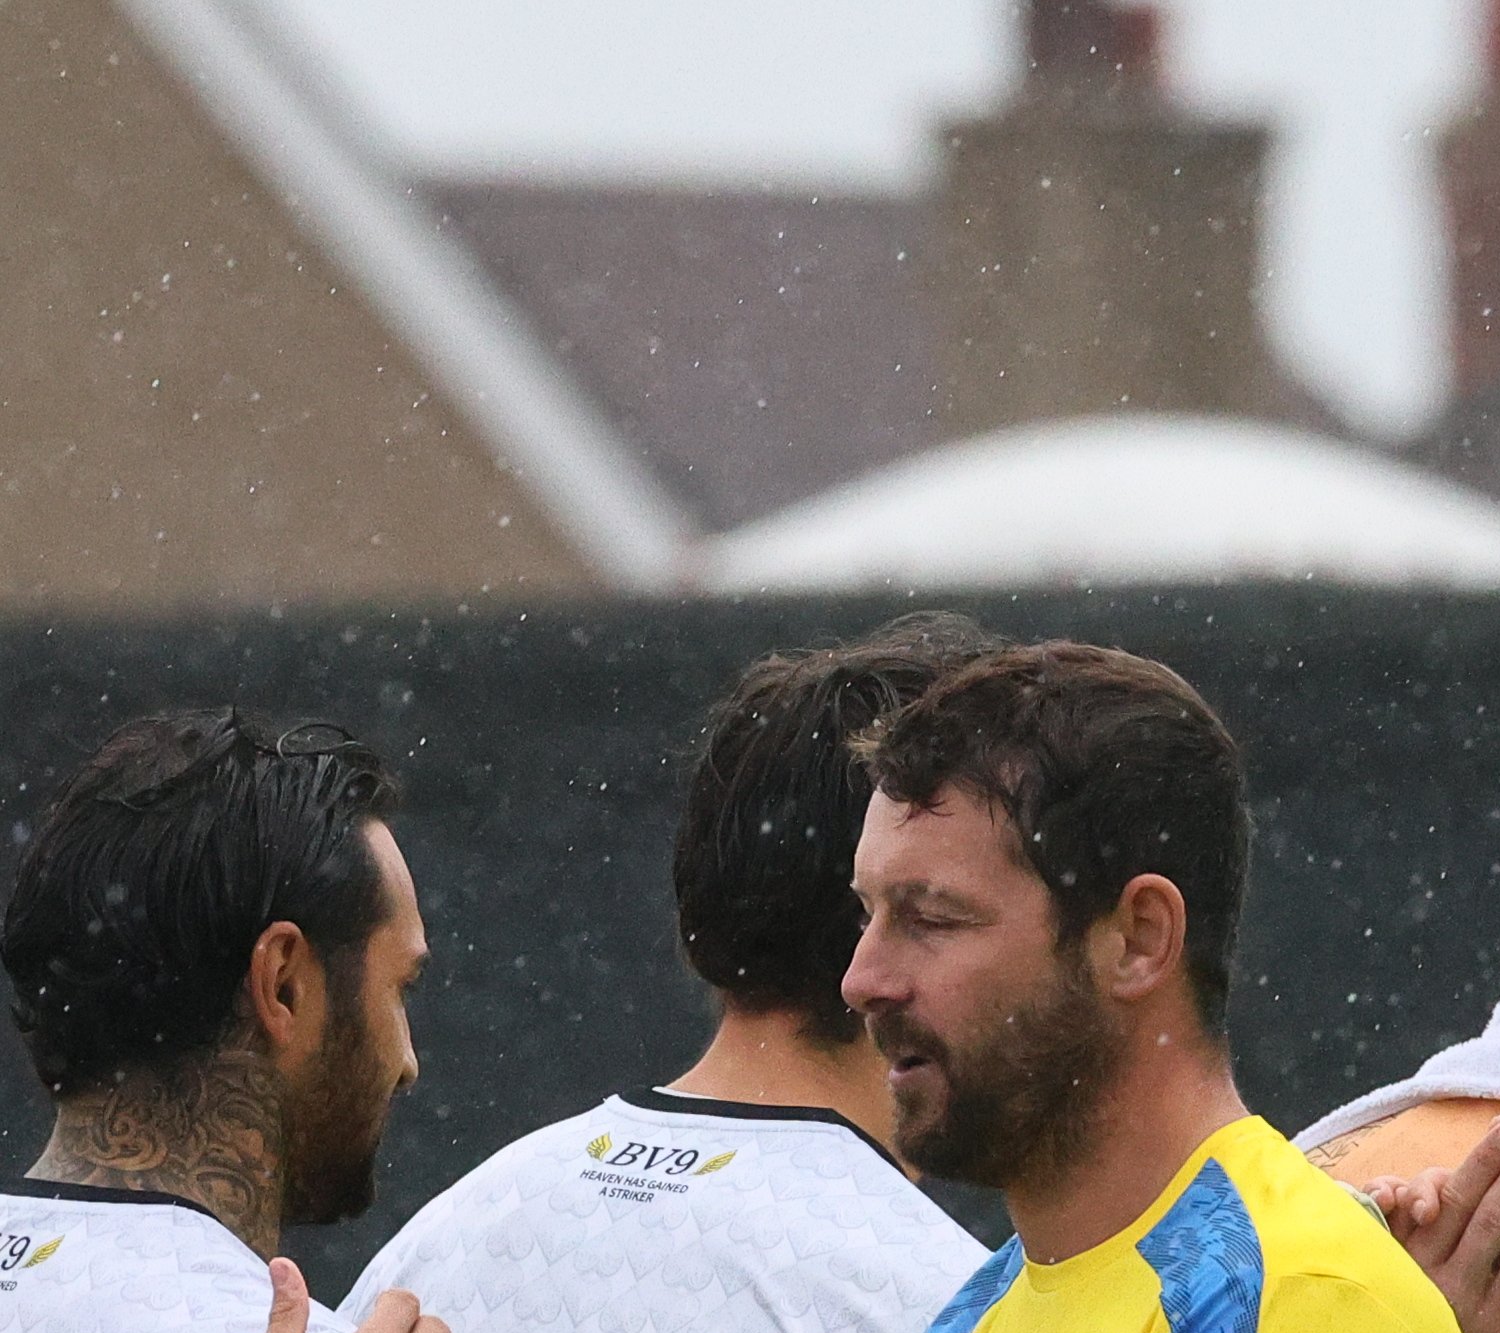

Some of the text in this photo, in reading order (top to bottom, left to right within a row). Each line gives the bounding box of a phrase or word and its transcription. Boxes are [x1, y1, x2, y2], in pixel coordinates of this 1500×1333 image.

[604, 1141, 699, 1175] BV9
[580, 1168, 689, 1194] HEAVEN HAS GAINED
[598, 1186, 655, 1203] A STRIKER
